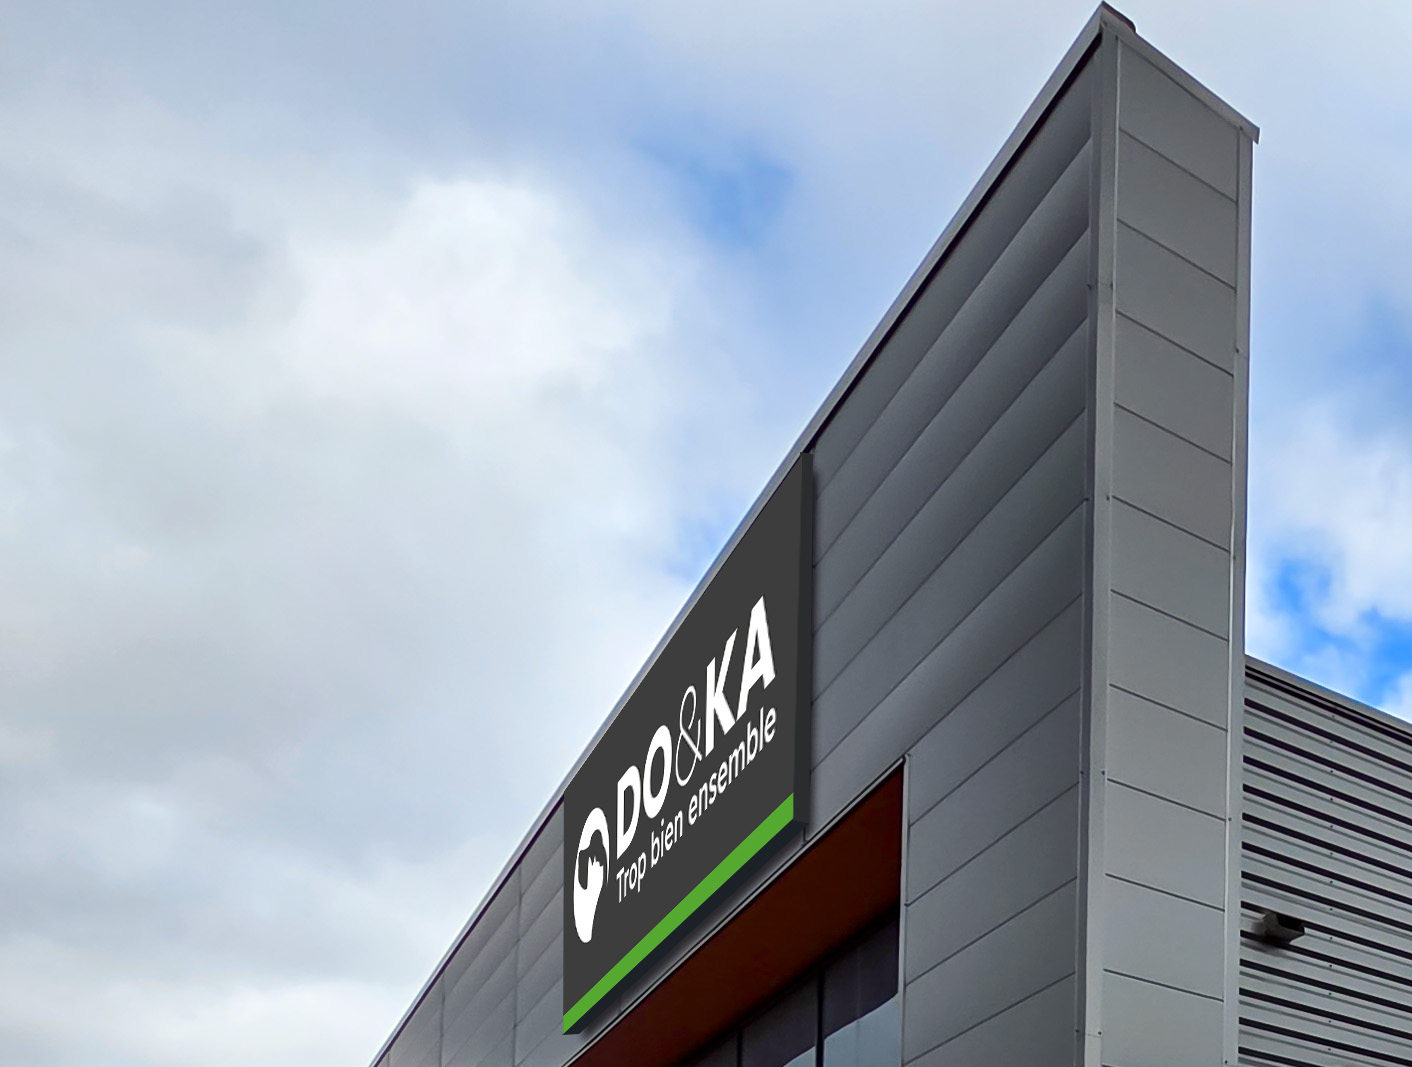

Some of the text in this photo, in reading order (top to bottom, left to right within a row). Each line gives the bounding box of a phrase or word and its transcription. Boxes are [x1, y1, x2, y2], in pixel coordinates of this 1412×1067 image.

[616, 707, 777, 903] Trop bien ensemble
[617, 596, 776, 859] DO&KA
